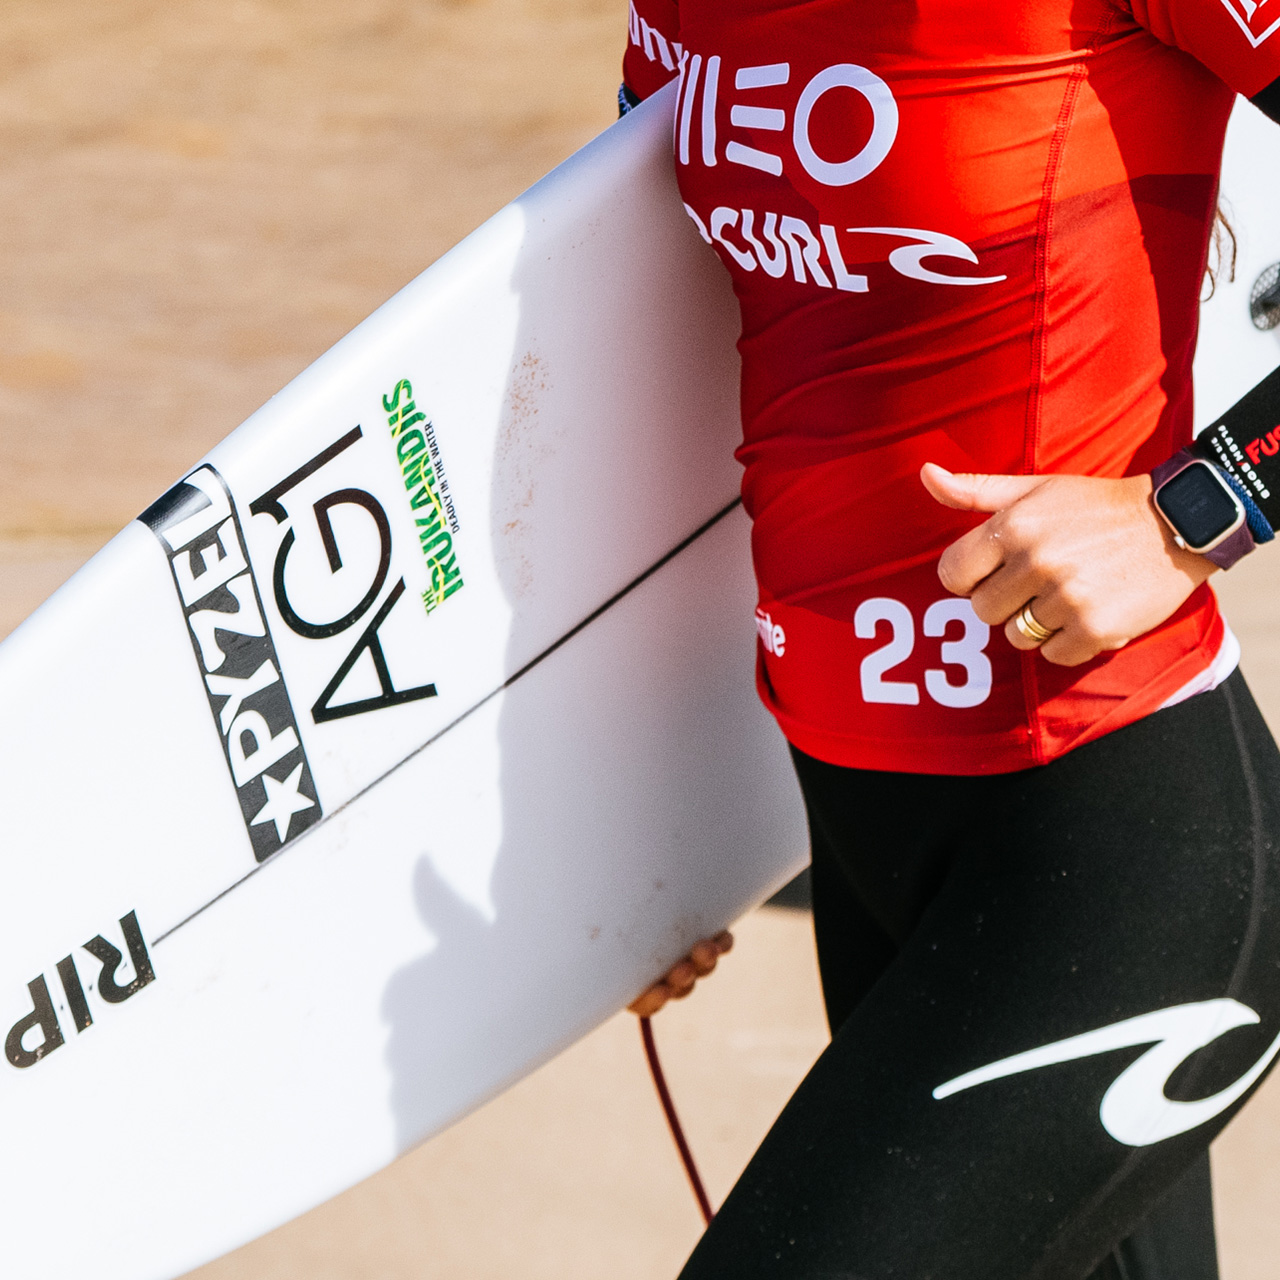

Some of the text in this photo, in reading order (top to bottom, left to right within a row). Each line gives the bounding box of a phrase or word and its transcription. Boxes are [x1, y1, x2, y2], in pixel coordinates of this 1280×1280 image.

[381, 377, 465, 606] IRUKANDJIS
[423, 420, 442, 460] WATER
[442, 494, 461, 534] DEADLY
[160, 466, 302, 789] PYZEL
[249, 424, 439, 725] AG1
[420, 584, 438, 617] THE
[853, 596, 993, 709] 23
